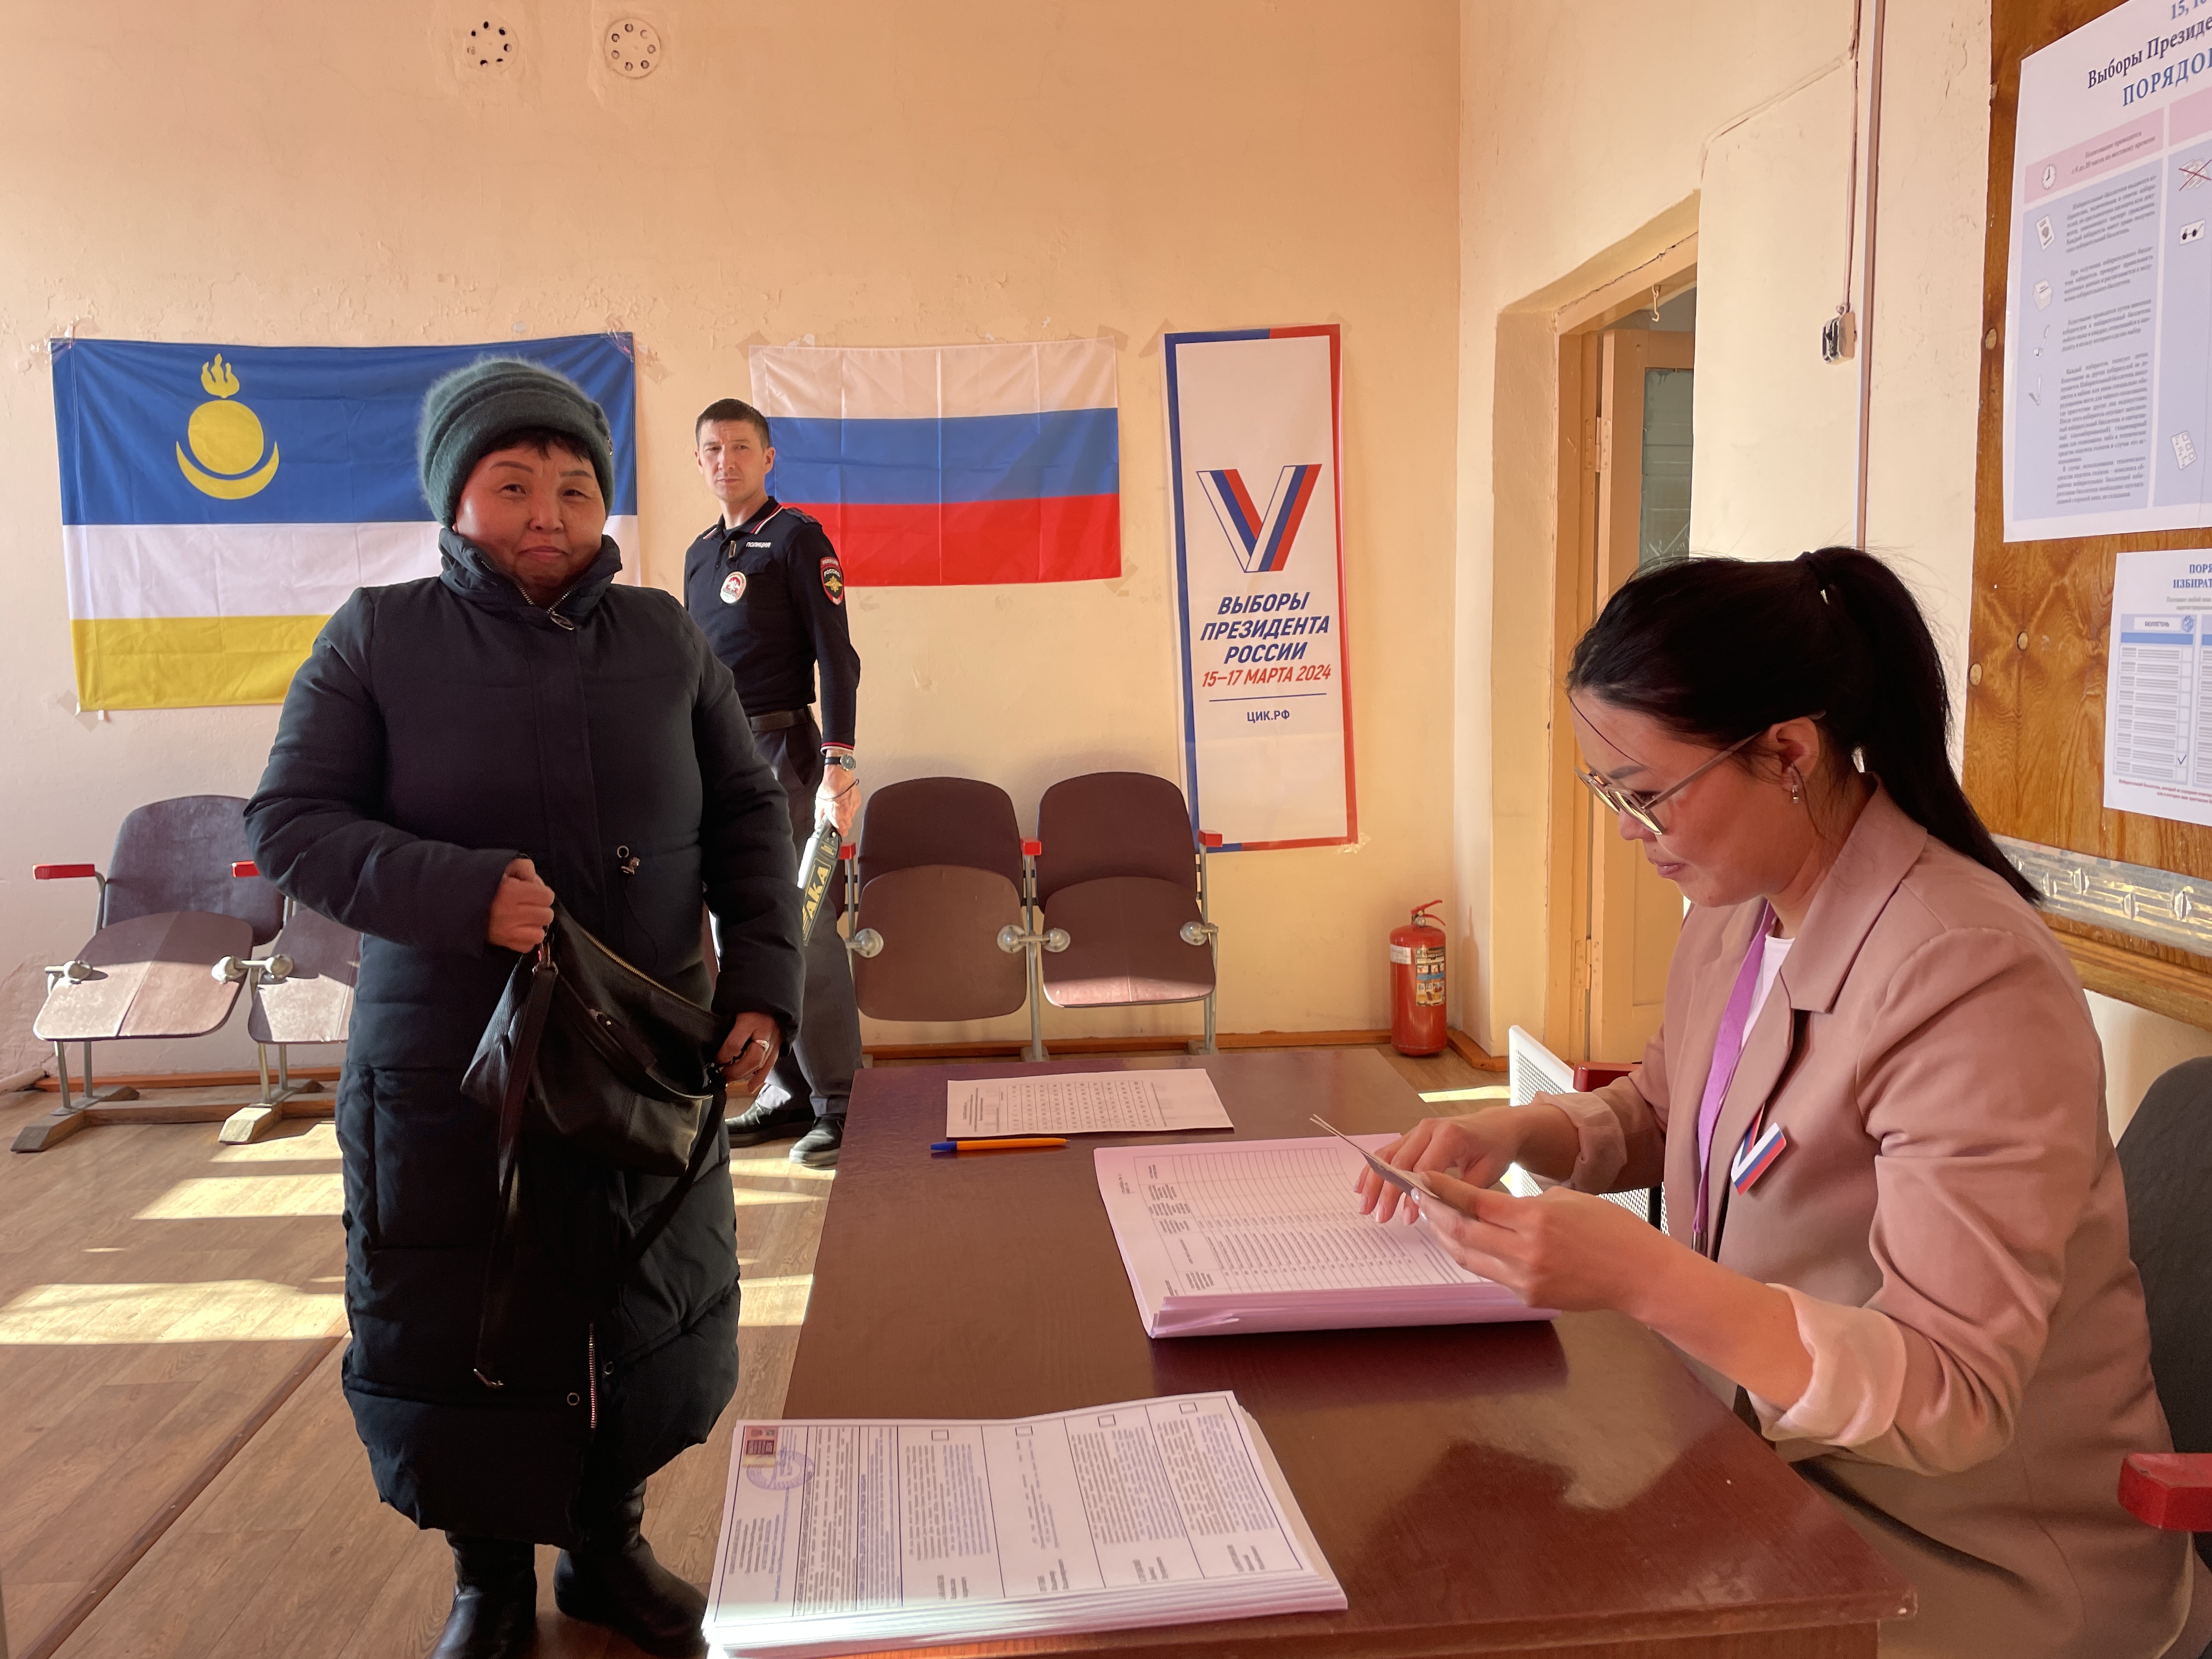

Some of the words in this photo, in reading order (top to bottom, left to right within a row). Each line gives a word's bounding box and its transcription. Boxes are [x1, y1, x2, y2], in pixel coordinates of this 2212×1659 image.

[2087, 50, 2143, 89] Выборы
[1217, 592, 1310, 615] ВЫБОРЫ
[1200, 616, 1329, 641] ПРЕЗИДЕНТА
[1223, 642, 1308, 664] РОССИИ
[1244, 667, 1293, 685] МАРТА
[1295, 664, 1331, 681] 2024
[1247, 709, 1290, 723] ЦИК.РФ
